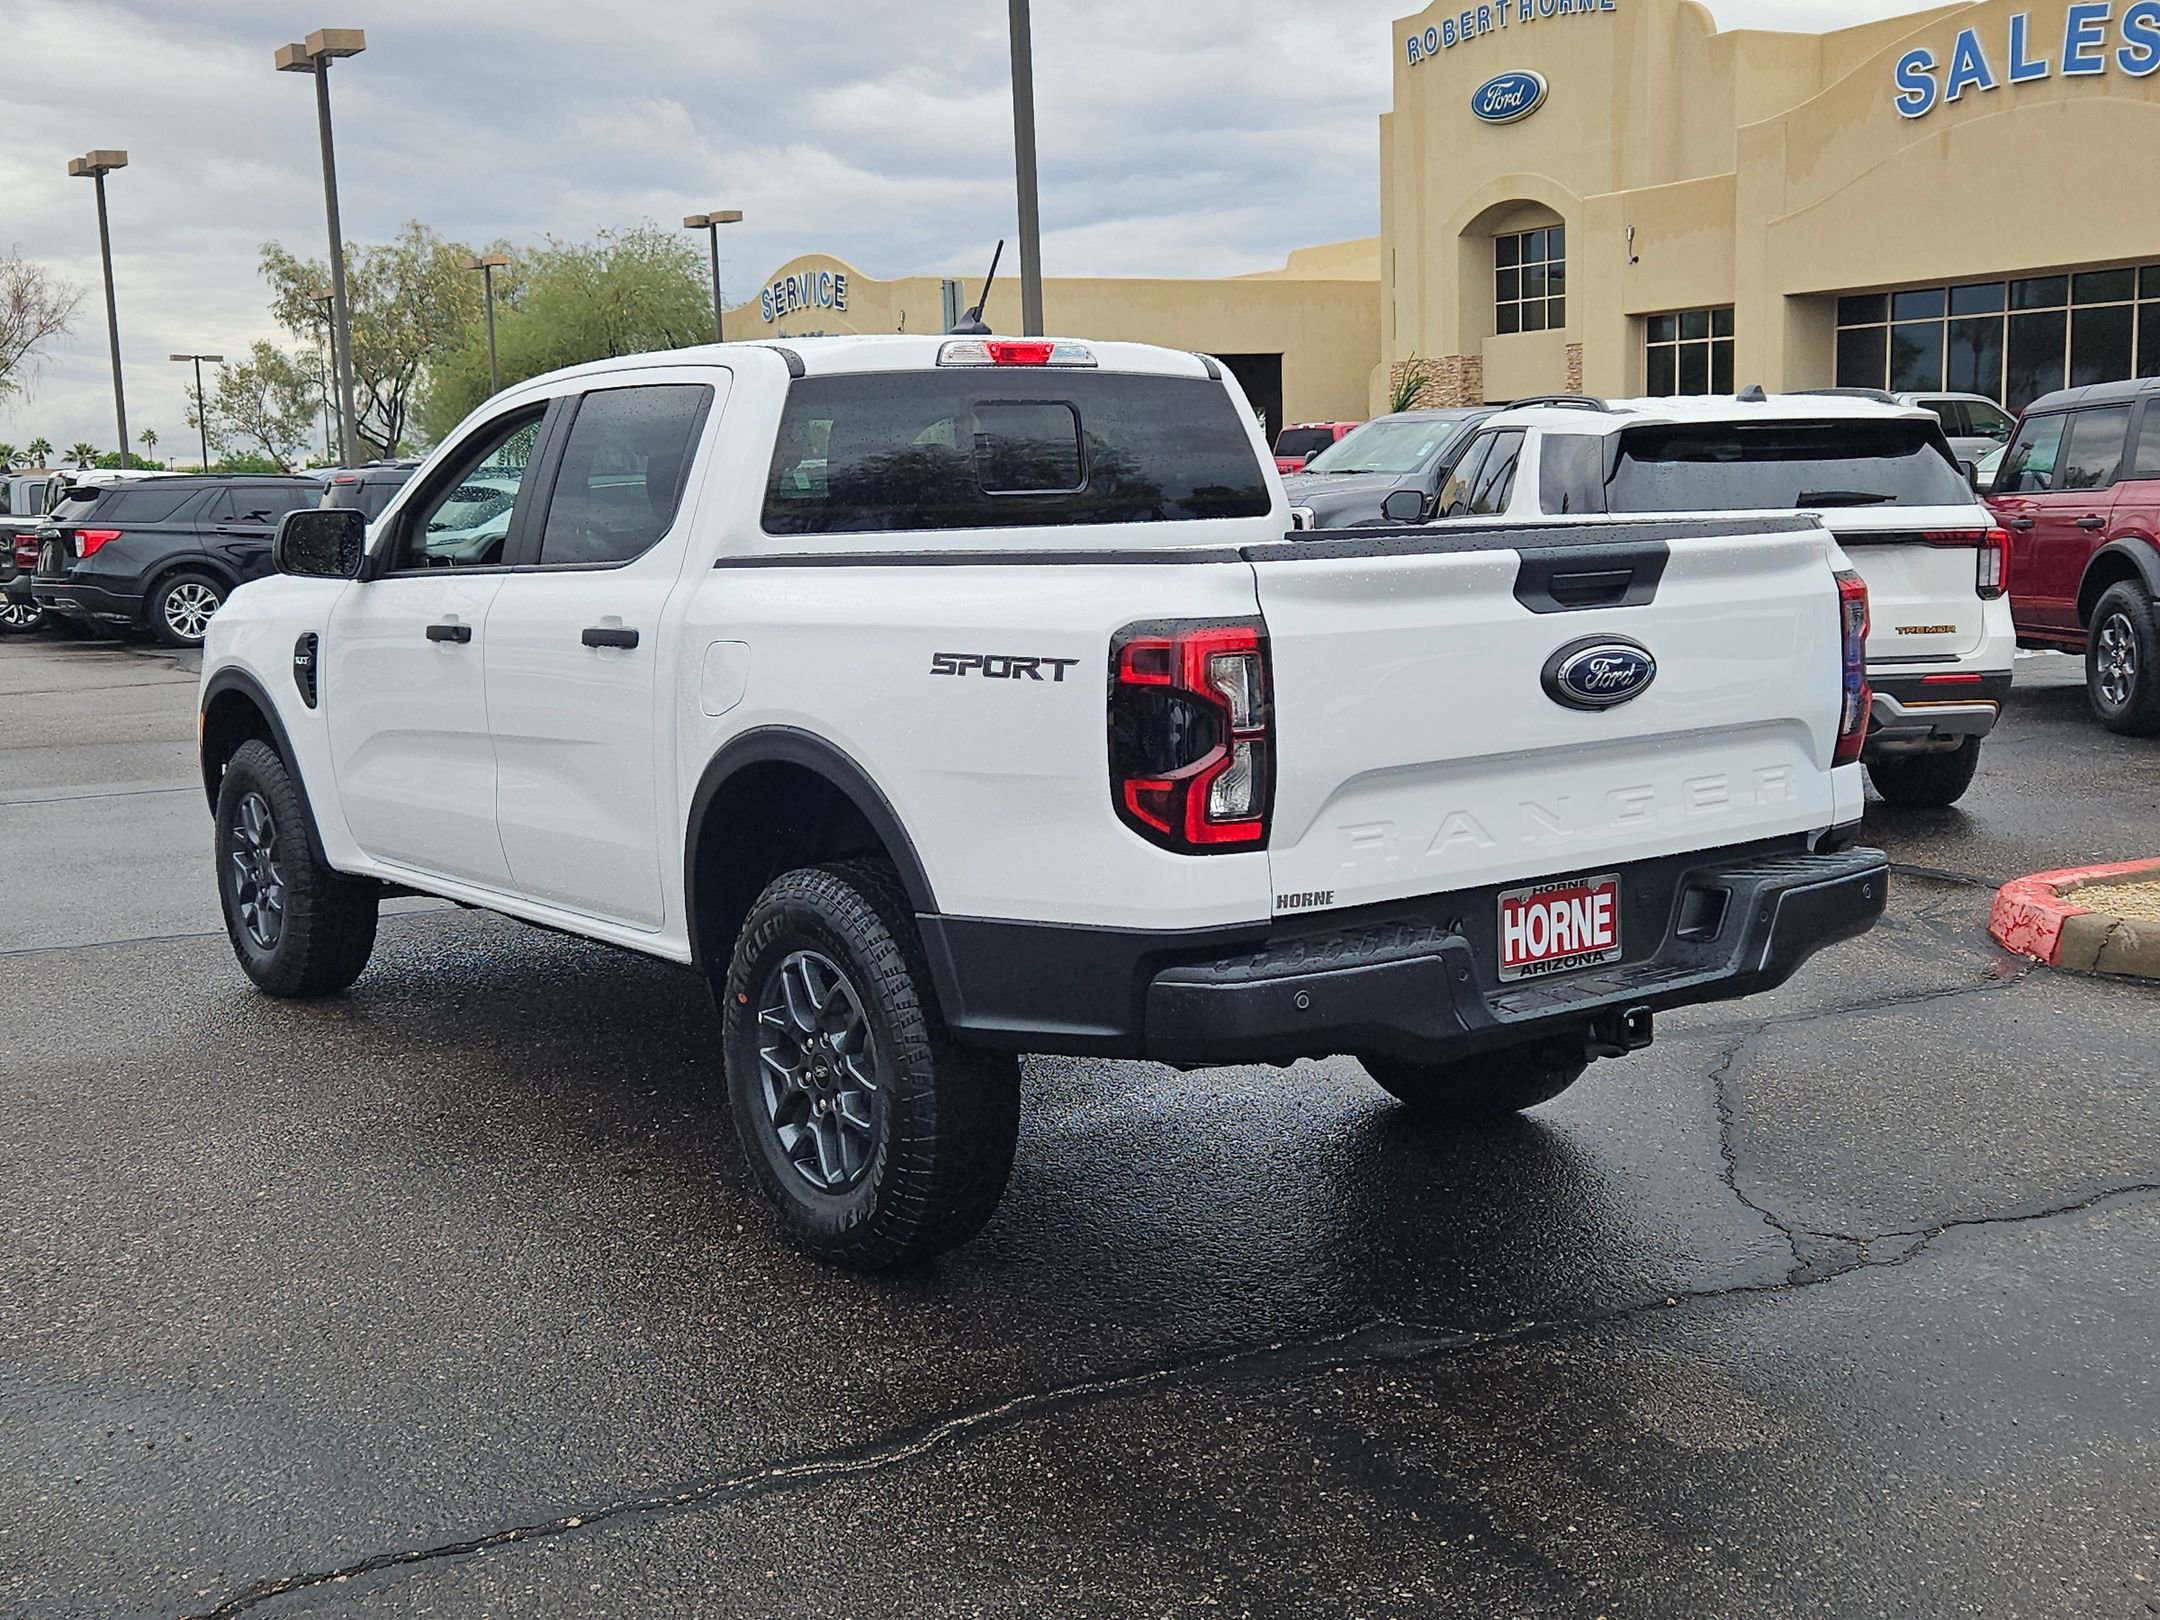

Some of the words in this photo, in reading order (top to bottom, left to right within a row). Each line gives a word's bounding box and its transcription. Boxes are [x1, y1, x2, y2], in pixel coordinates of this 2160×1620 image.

[1406, 0, 1511, 65] ROBERT
[1894, 0, 2160, 118] SALES
[1483, 81, 1525, 112] Ford
[761, 270, 849, 322] SERVICE
[1895, 625, 1956, 635] TREMOR
[929, 652, 1081, 682] SPORT
[1585, 657, 1635, 690] Ford
[1336, 763, 1798, 869] RANGER
[1276, 890, 1334, 909] HORNE
[1532, 879, 1589, 895] HORNE
[1504, 893, 1612, 962] HORNE
[1520, 950, 1605, 977] ARIZONA
